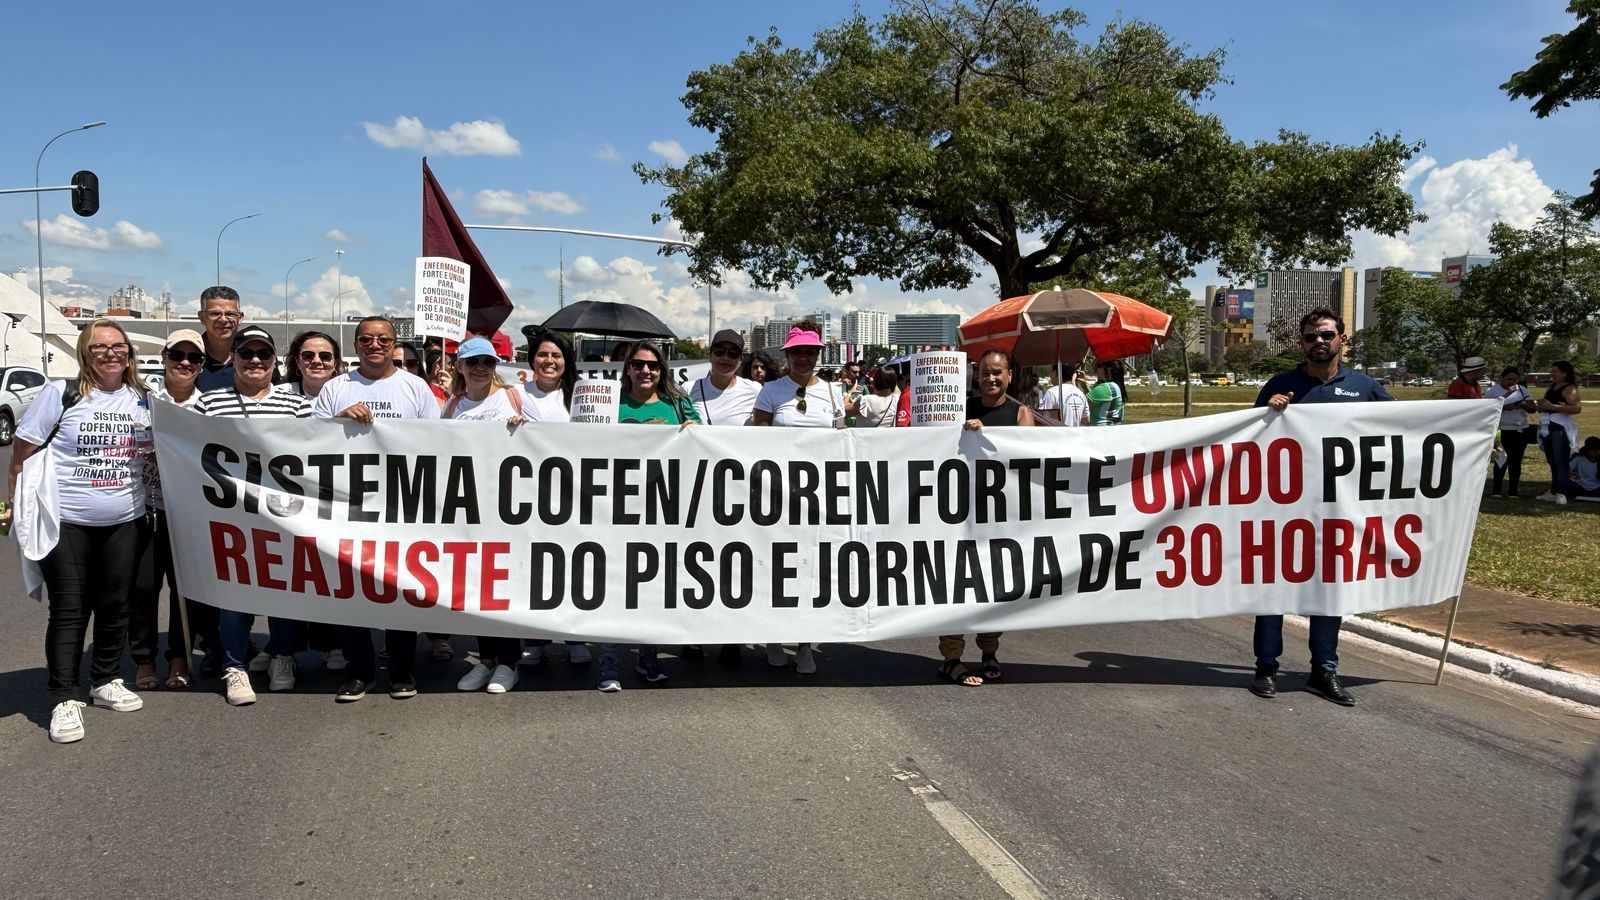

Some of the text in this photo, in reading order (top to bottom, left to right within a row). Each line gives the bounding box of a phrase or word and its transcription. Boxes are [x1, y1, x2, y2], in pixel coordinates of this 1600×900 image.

[424, 262, 465, 275] ENFERMAGEM
[423, 270, 465, 284] FORTE E UNIDA
[438, 279, 454, 290] PARA
[423, 287, 465, 302] CONQUISTAR O
[425, 295, 463, 310] REAJUSTE DO
[417, 304, 466, 320] PISO E A JORNADA
[425, 313, 461, 327] DE 30 HORAS
[916, 356, 958, 367] ENFERMAGEM
[916, 366, 959, 376] FORTE E UNIDA
[927, 375, 944, 384] PARA
[915, 384, 959, 395] CONQUISTAR O
[590, 394, 612, 405] UNIDA
[917, 394, 957, 404] REAJUSTE DO
[579, 405, 595, 413] PARA
[912, 403, 964, 414] PISO E A JORNADA
[93, 411, 133, 422] SISTEMA
[917, 414, 924, 423] DE
[924, 414, 932, 422] 30
[933, 413, 956, 422] HORAS
[77, 434, 110, 446] FORTE
[111, 435, 117, 446] E
[76, 447, 99, 457] PELO
[72, 467, 117, 480] JORNADA
[201, 432, 1455, 528] SISTEMA COFEN/COREN FORTE E UNIDO PELO
[209, 513, 1424, 612] REAJUSTE DO PISO E JORNADA DE 30 HORAS
